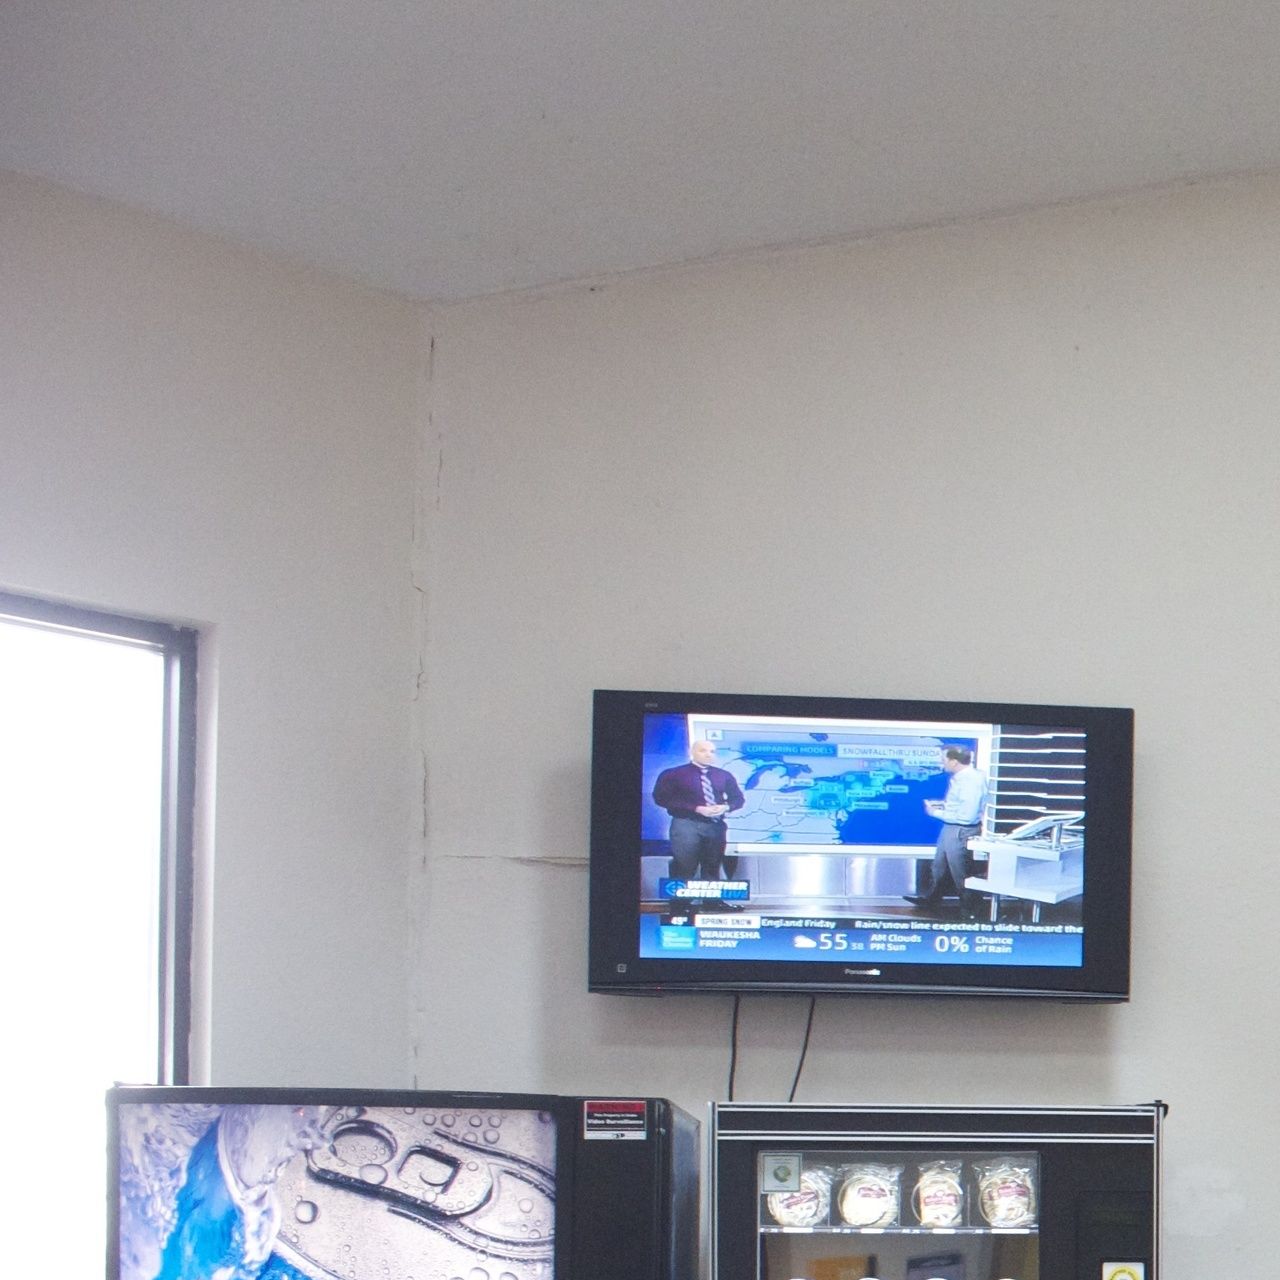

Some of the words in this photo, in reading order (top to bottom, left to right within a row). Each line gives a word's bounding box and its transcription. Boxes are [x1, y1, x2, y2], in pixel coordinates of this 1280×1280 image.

[687, 881, 748, 890] WEATHER
[761, 918, 803, 928] England
[805, 919, 836, 930] Friday
[855, 920, 909, 930] Rain/snow
[911, 921, 930, 930] line
[932, 922, 980, 932] expected
[981, 923, 992, 932] to
[994, 923, 1019, 933] slide
[1021, 924, 1060, 933] toward
[1062, 925, 1084, 934] the
[700, 931, 761, 939] WAUKESHA
[870, 934, 886, 943] AM
[888, 934, 922, 943] Clouds
[700, 940, 738, 948] FRIDAY
[819, 933, 848, 950] 55
[935, 935, 970, 953] 0%
[975, 936, 1013, 945] Chance
[870, 943, 886, 951] PM
[887, 943, 906, 952] Sun
[975, 945, 986, 953] of
[987, 945, 1012, 953] Rain
